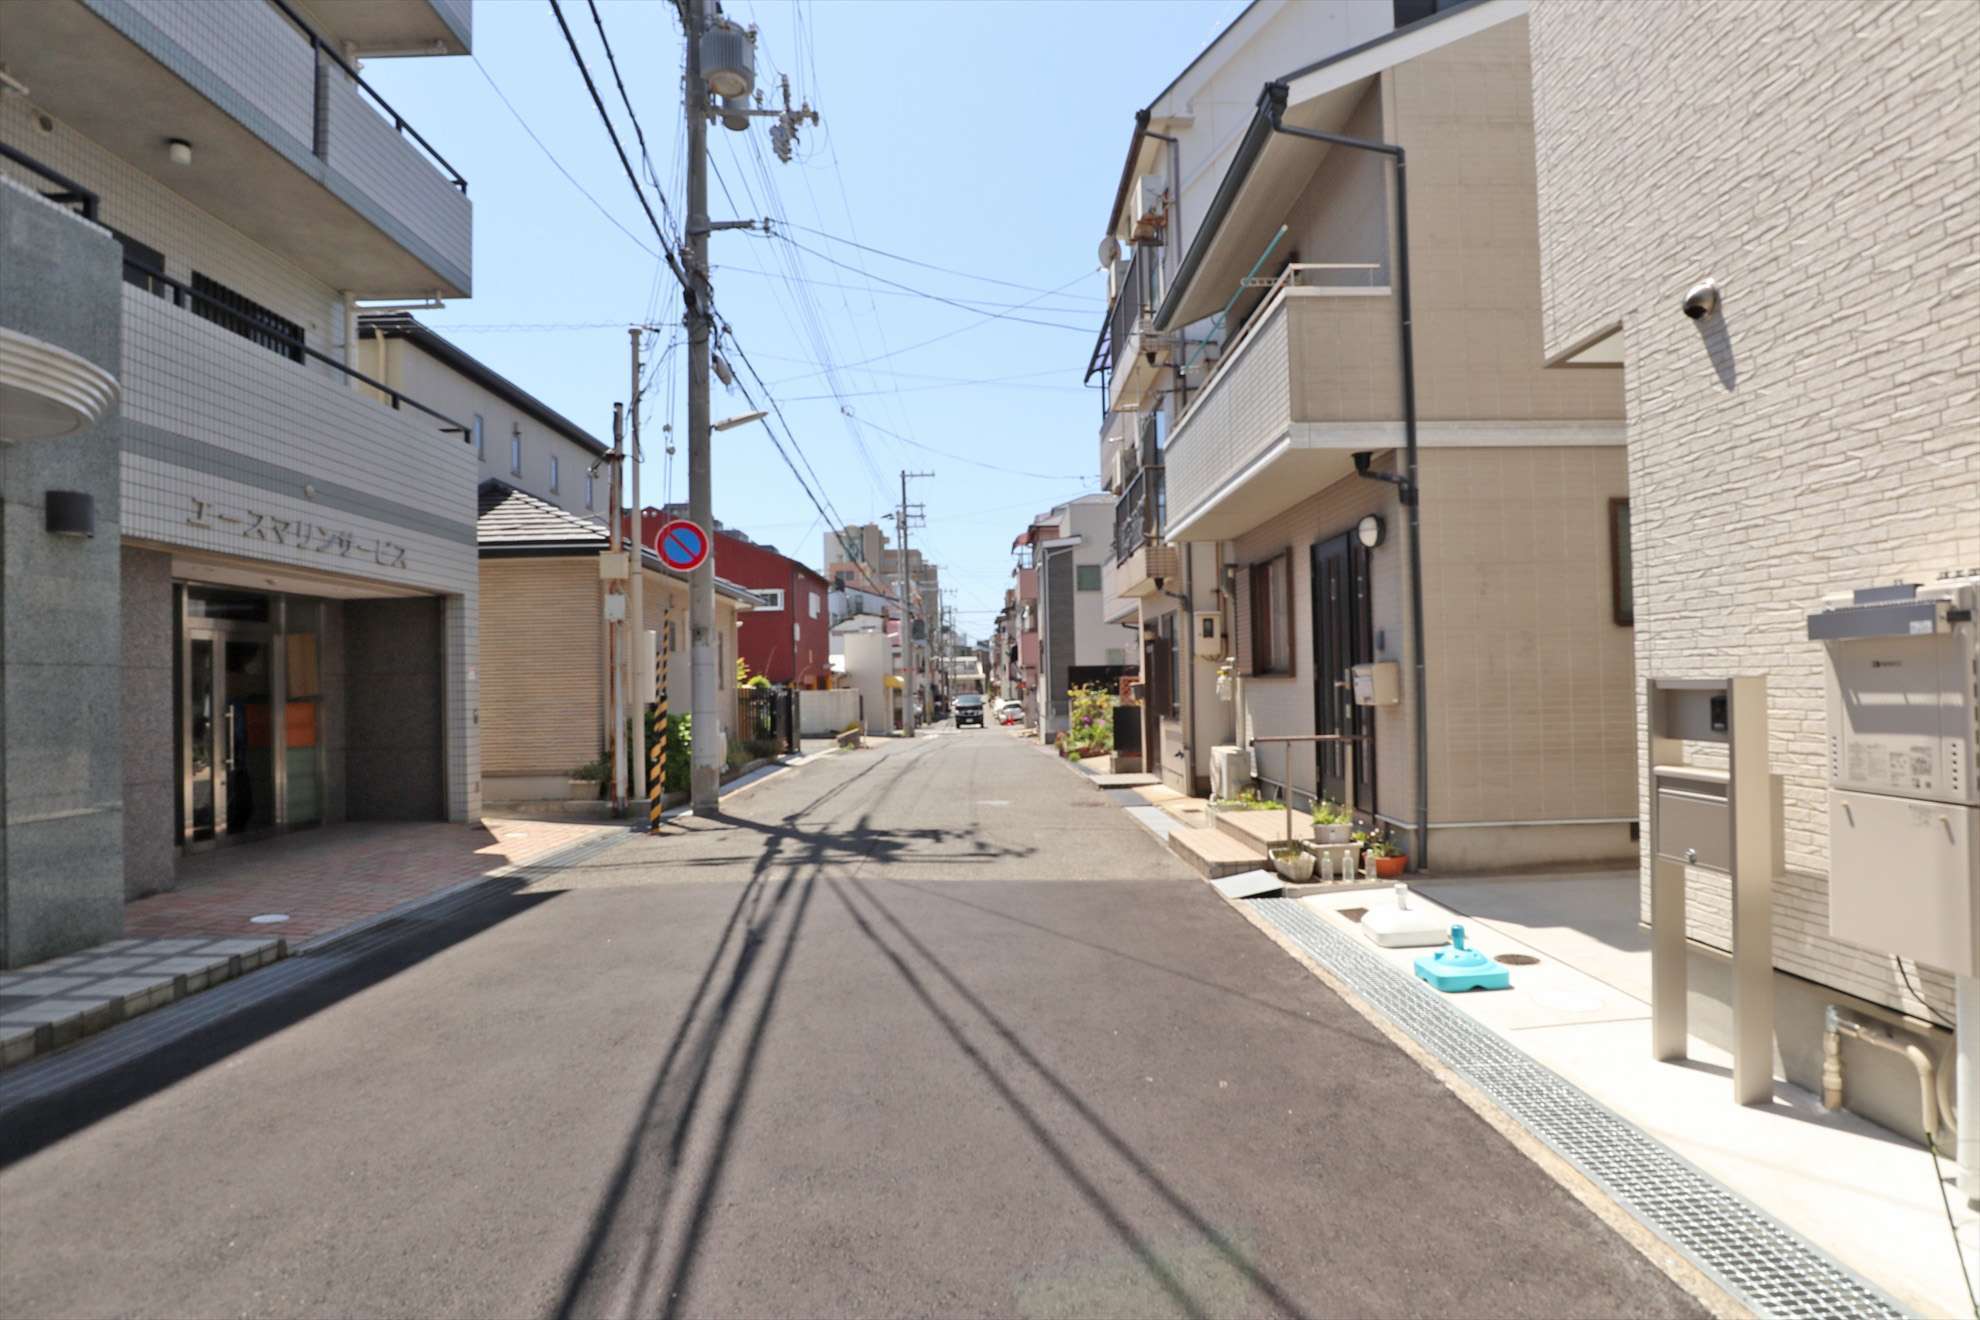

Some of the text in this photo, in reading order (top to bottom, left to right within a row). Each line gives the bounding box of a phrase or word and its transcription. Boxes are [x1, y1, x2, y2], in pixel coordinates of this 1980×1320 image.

[186, 496, 407, 570] エースマリンサービス
